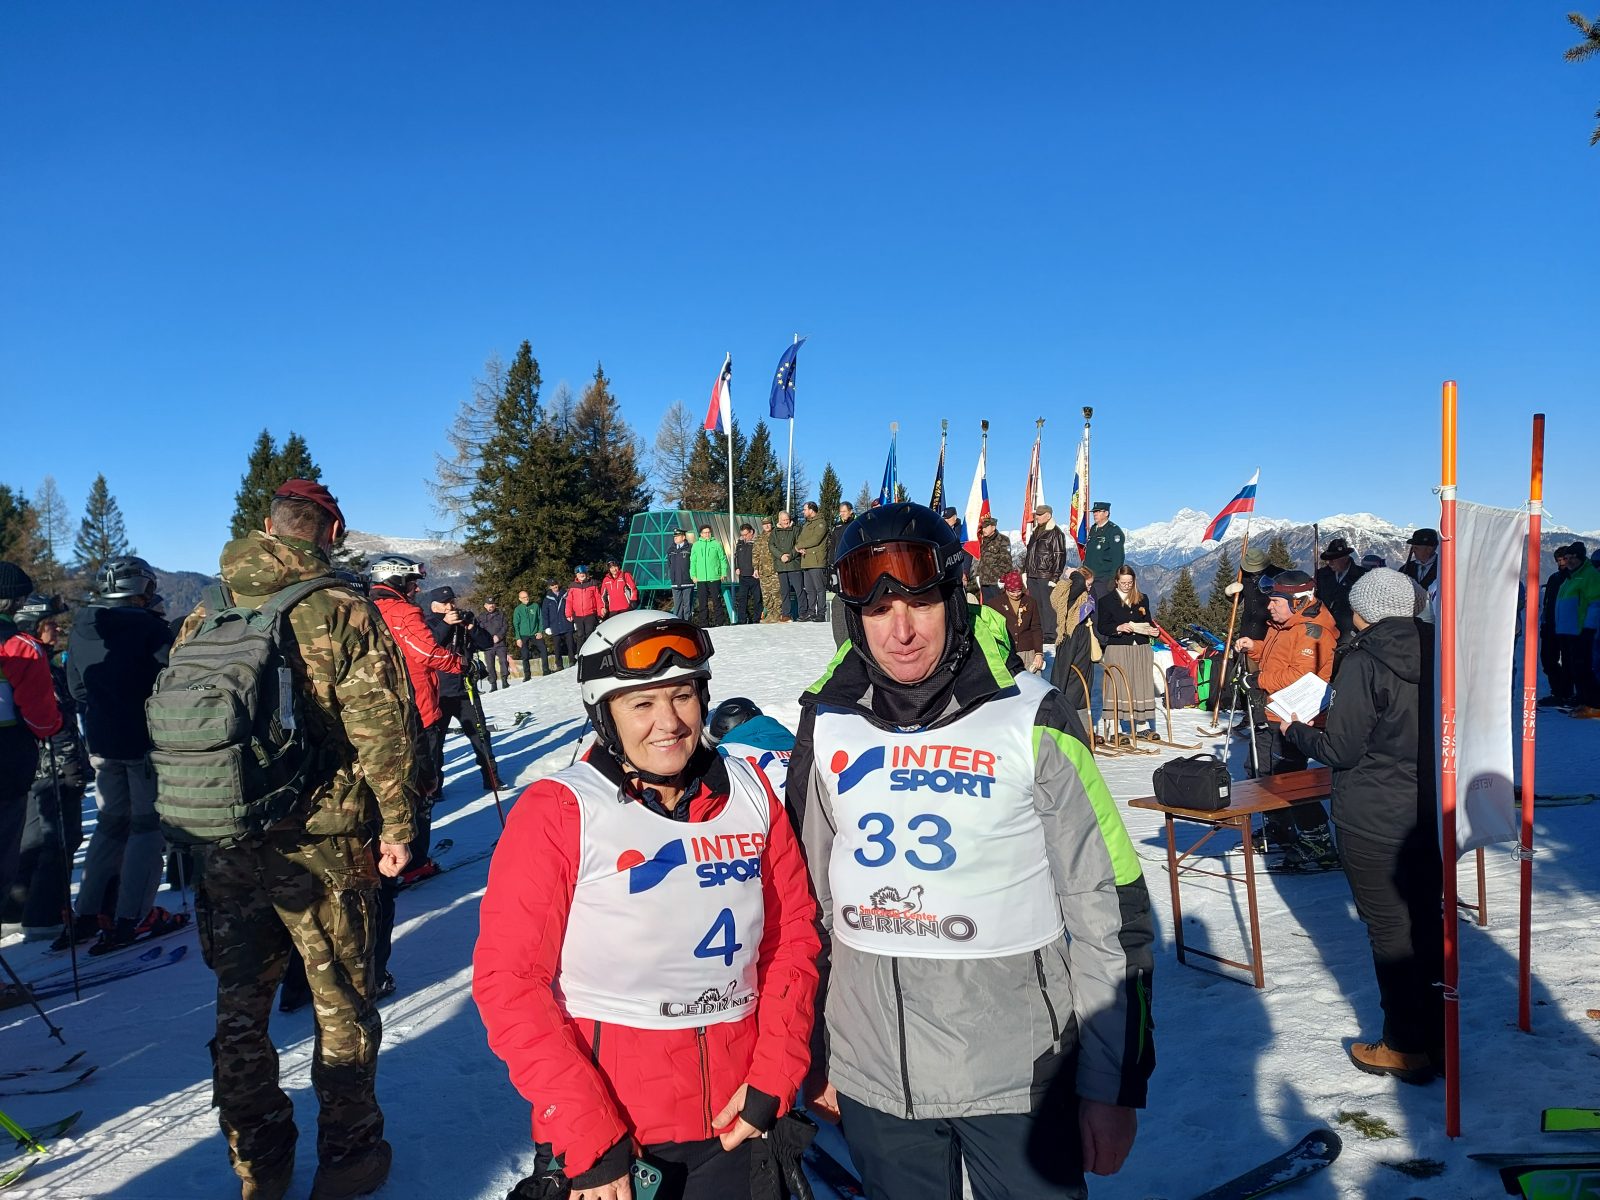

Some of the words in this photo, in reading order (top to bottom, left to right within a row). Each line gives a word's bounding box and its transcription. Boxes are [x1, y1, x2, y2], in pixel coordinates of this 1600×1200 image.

[1442, 713, 1451, 768] LISKI
[891, 745, 996, 776] INTER
[889, 769, 996, 798] SPORT
[691, 833, 765, 862] INTER
[853, 812, 957, 871] 33
[693, 907, 743, 966] 4
[841, 904, 978, 943] CERKNO
